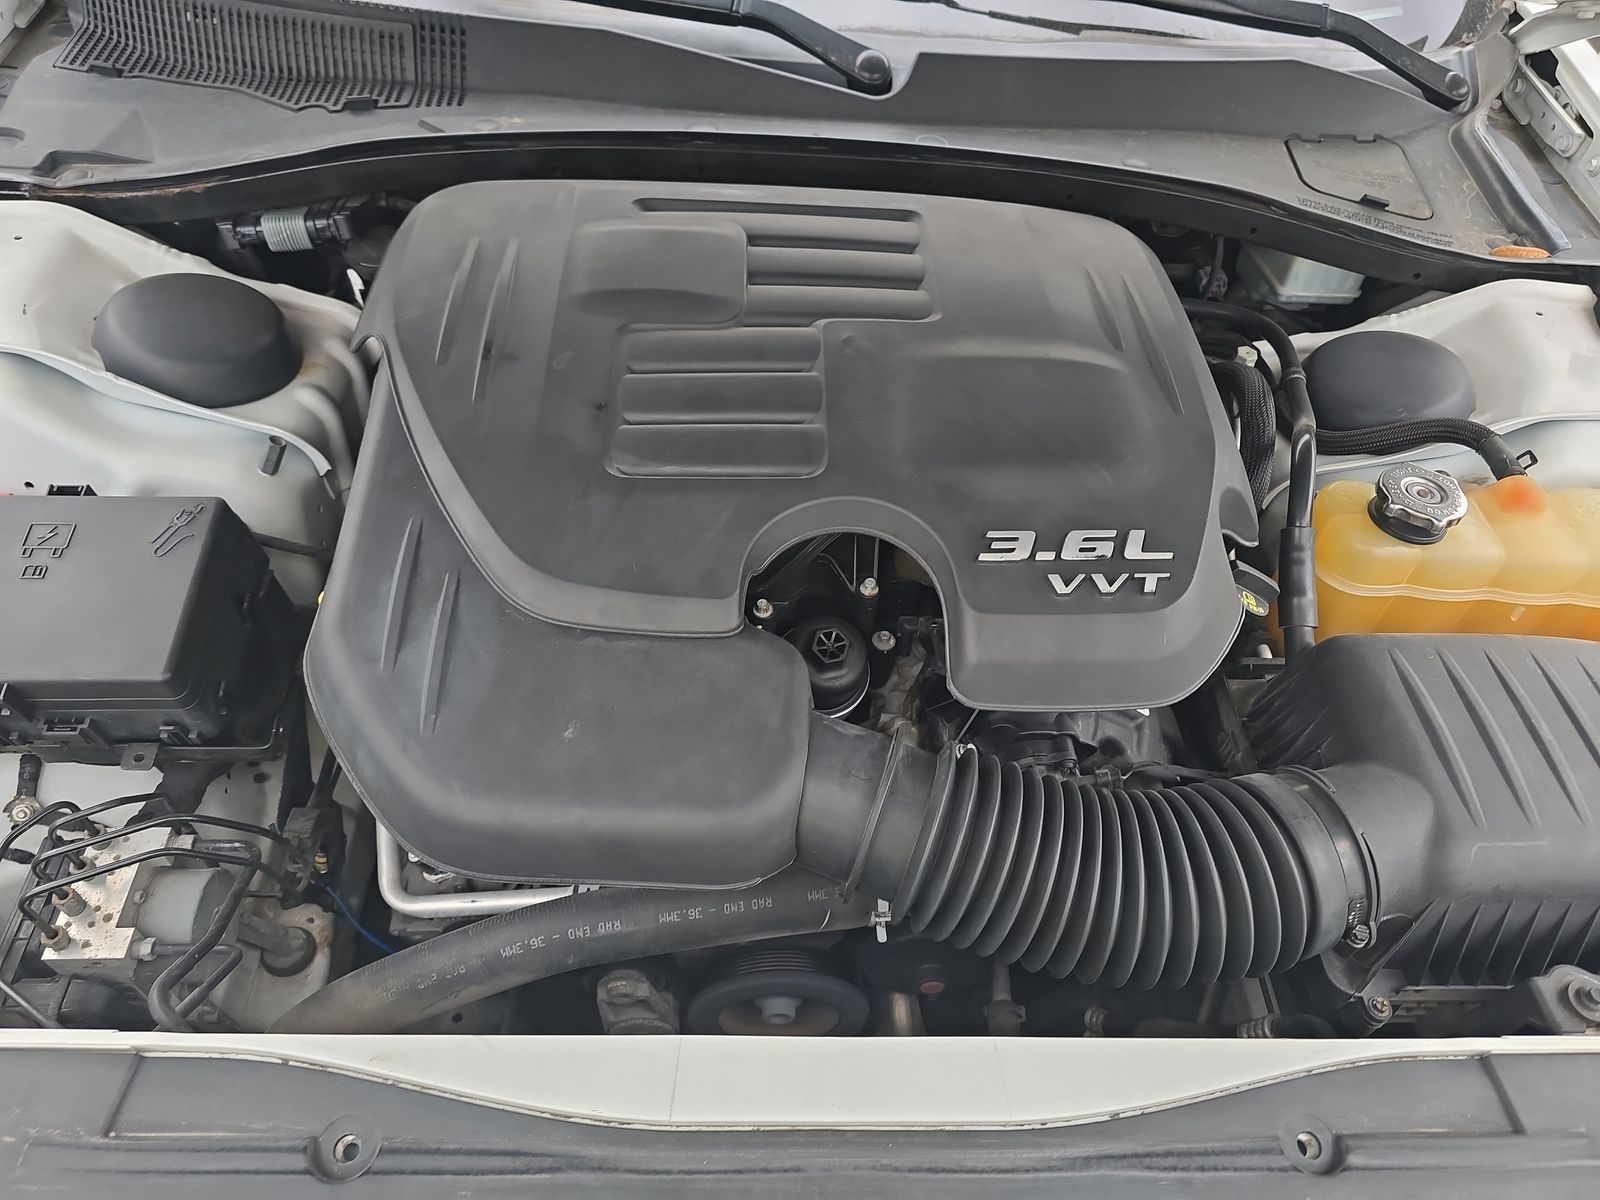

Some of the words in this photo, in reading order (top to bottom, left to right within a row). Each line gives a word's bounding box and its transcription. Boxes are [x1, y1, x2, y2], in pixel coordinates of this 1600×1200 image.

[977, 529, 1174, 562] 3.6L
[1047, 573, 1171, 595] VVT
[723, 901, 744, 915] END
[752, 897, 773, 910] RAD
[658, 907, 703, 924] 36.3MM
[567, 925, 591, 939] END
[500, 936, 546, 958] 36.3MM
